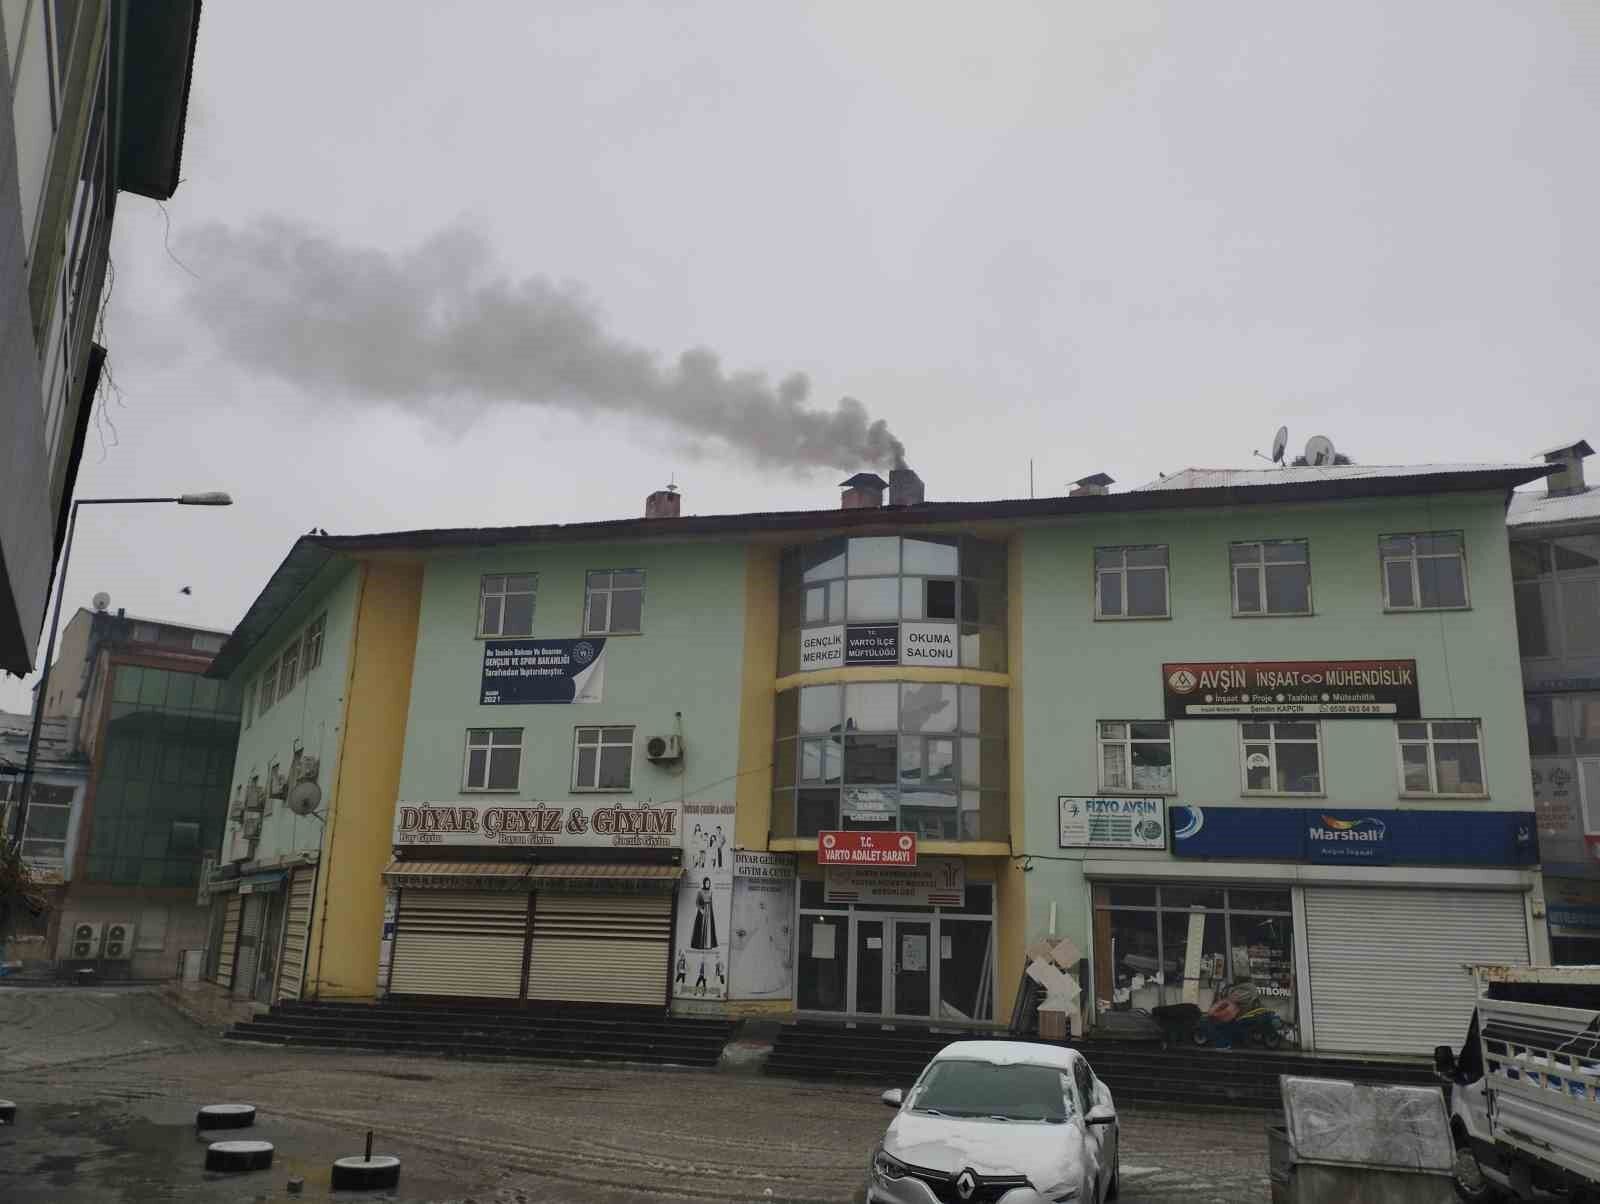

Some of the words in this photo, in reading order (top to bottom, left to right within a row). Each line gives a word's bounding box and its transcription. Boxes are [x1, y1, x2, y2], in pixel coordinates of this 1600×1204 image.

[804, 632, 842, 648] GENÇLİK
[849, 639, 876, 648] VARTO
[877, 637, 896, 647] İLÇE
[909, 633, 951, 644] OKUMA
[803, 648, 841, 663] MERKEZİ
[848, 647, 896, 657] MÜFTÜLÜĞÜ
[906, 647, 953, 658] SALONU
[1199, 665, 1247, 692] AVŞİN
[1256, 668, 1300, 690] İNŞAAT
[1327, 667, 1413, 687] MÜHENDİSLİK
[1253, 694, 1273, 704] Proje
[1085, 798, 1119, 813] FİZYO
[1121, 798, 1156, 815] AVŞİN
[399, 803, 479, 832] DİYAR
[482, 802, 563, 838] ÇEYİZ
[566, 808, 589, 834] &
[591, 803, 677, 834] GİYİM
[1309, 827, 1377, 841] Marshall
[860, 836, 874, 848] T.C.
[825, 850, 850, 860] VARTO
[852, 851, 881, 861] ADALET
[882, 851, 910, 862] SARAYI
